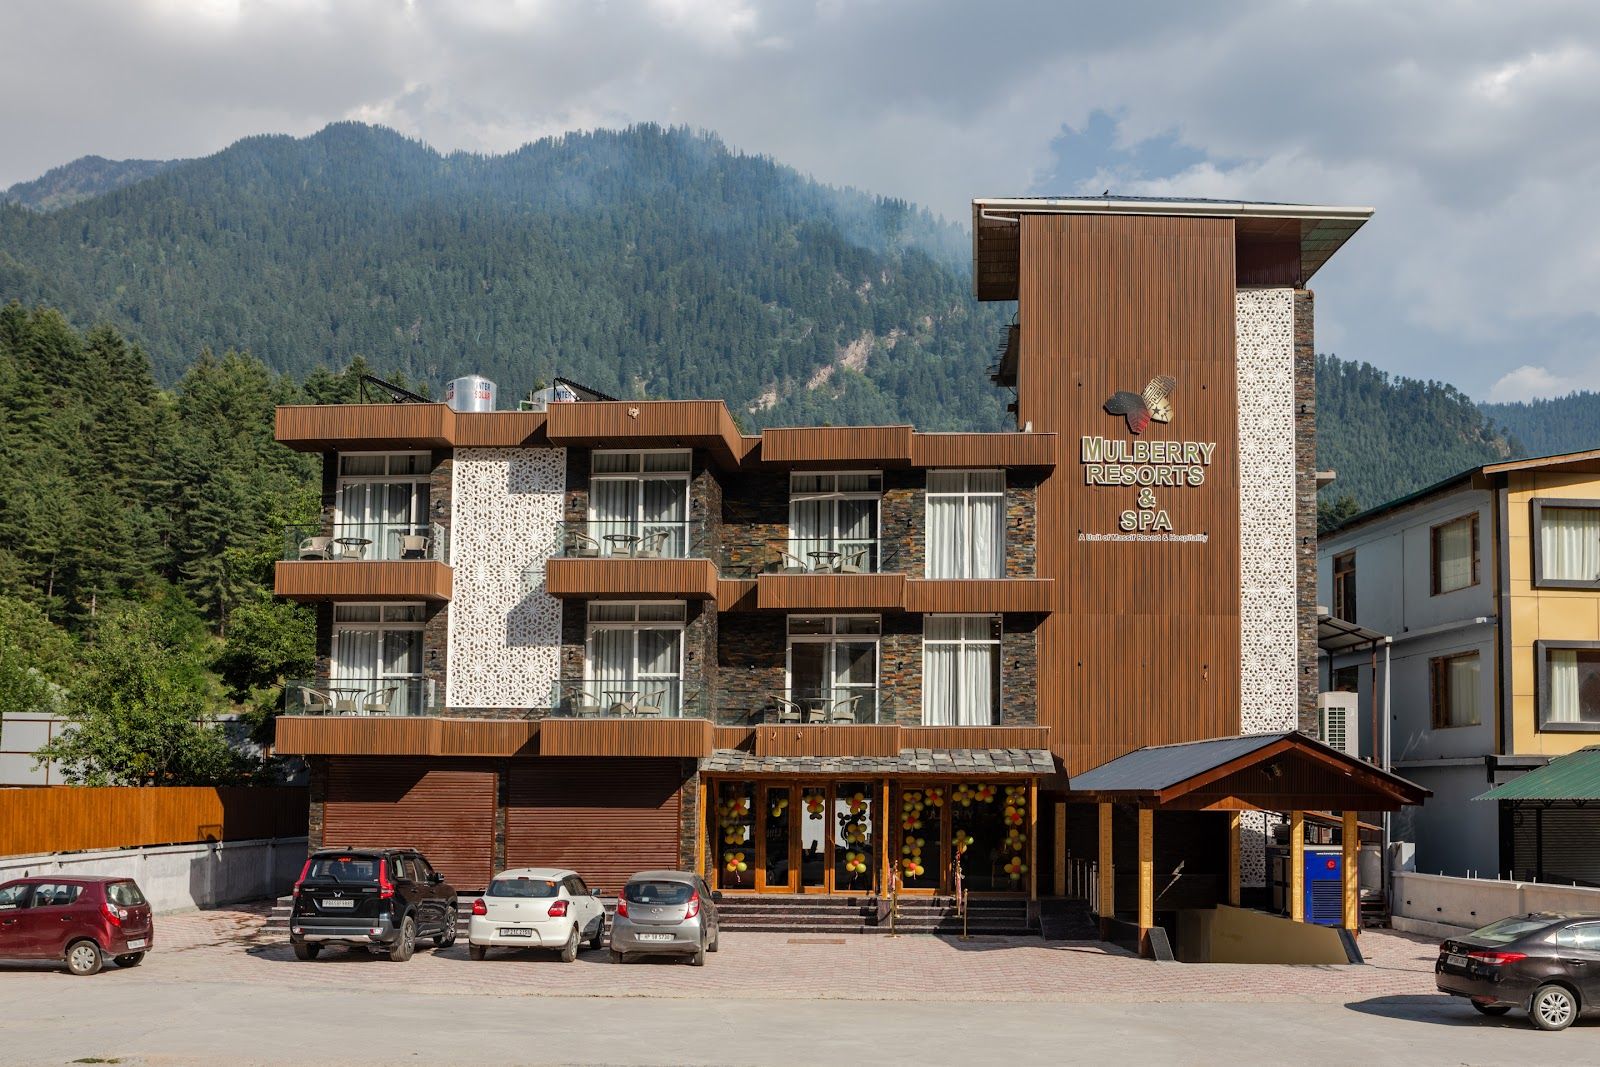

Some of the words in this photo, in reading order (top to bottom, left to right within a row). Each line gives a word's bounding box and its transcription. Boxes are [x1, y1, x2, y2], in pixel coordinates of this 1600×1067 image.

[1081, 436, 1216, 464] MULBERRY
[1086, 463, 1205, 486] RESORTS
[1137, 487, 1157, 508] &
[1120, 509, 1173, 531] SPA
[1086, 533, 1101, 542] Unit
[1137, 533, 1162, 542] Resort
[1169, 533, 1209, 544] Hospitality
